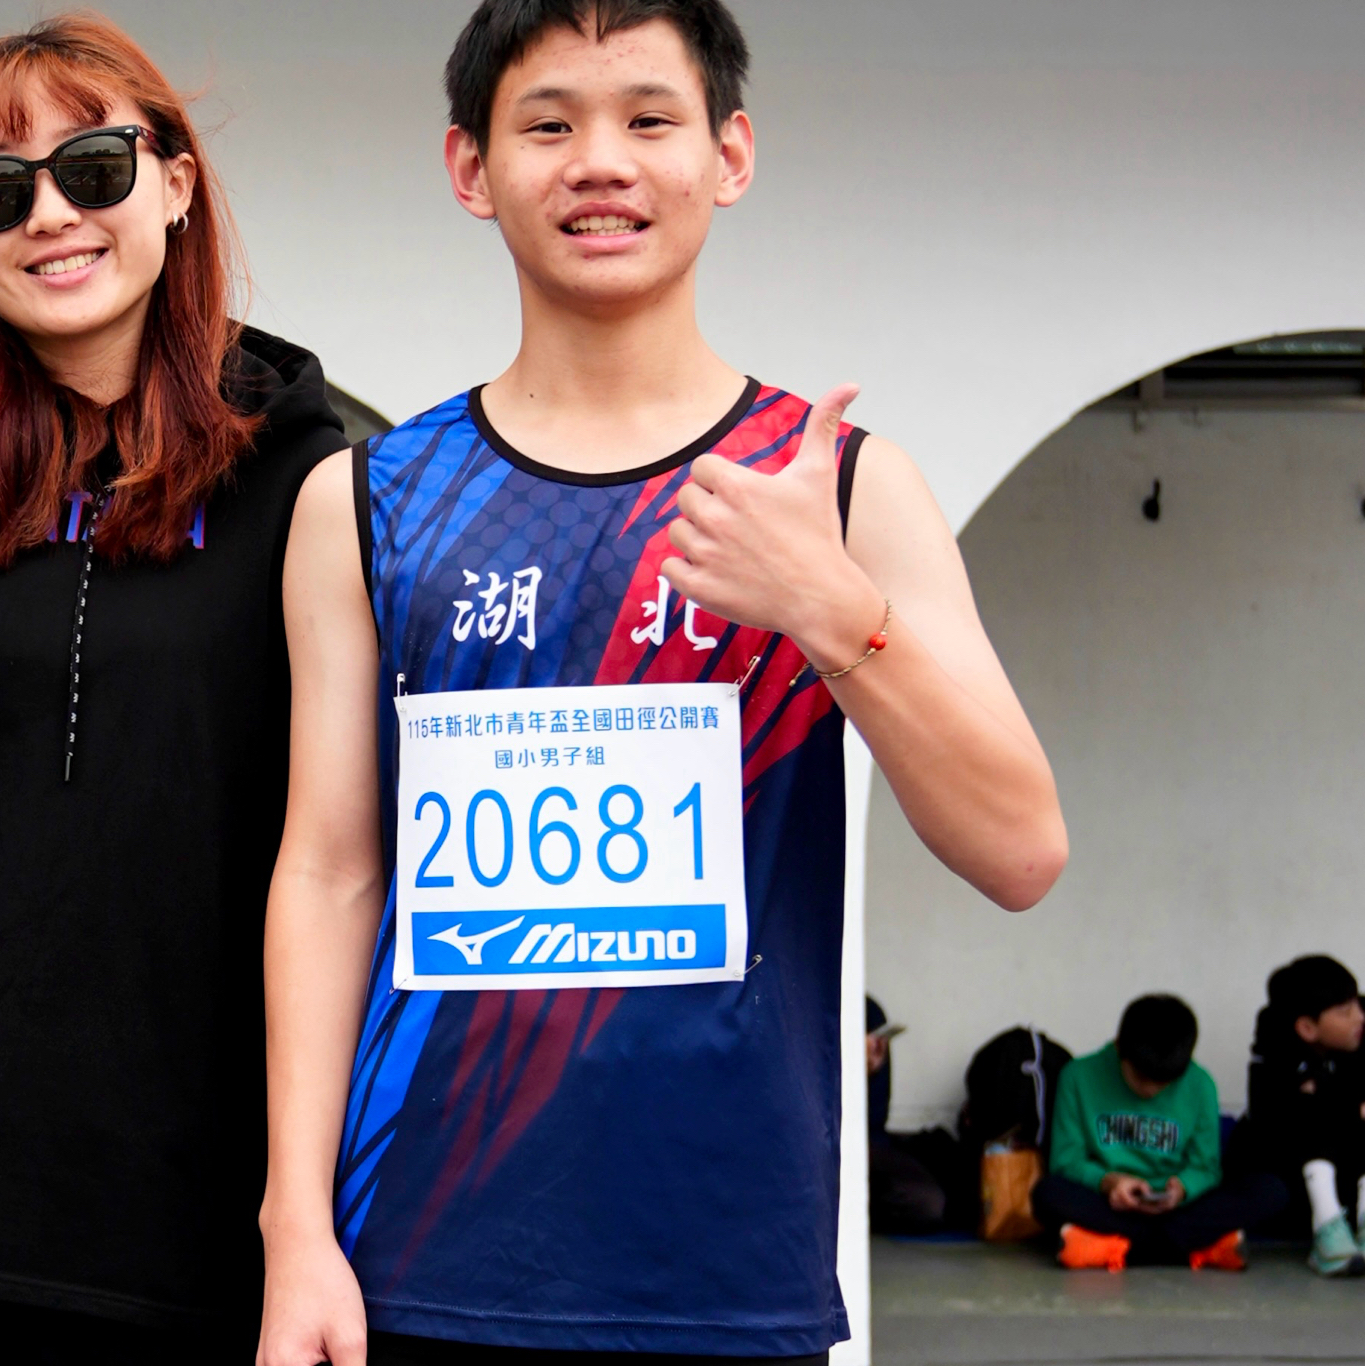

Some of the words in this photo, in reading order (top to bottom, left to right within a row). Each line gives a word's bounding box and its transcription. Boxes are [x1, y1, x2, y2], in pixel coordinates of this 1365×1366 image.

[407, 705, 720, 740] 115年新北市青年盃全國田徑公開賽
[494, 746, 606, 769] 國小男子組
[414, 781, 705, 889] 20681
